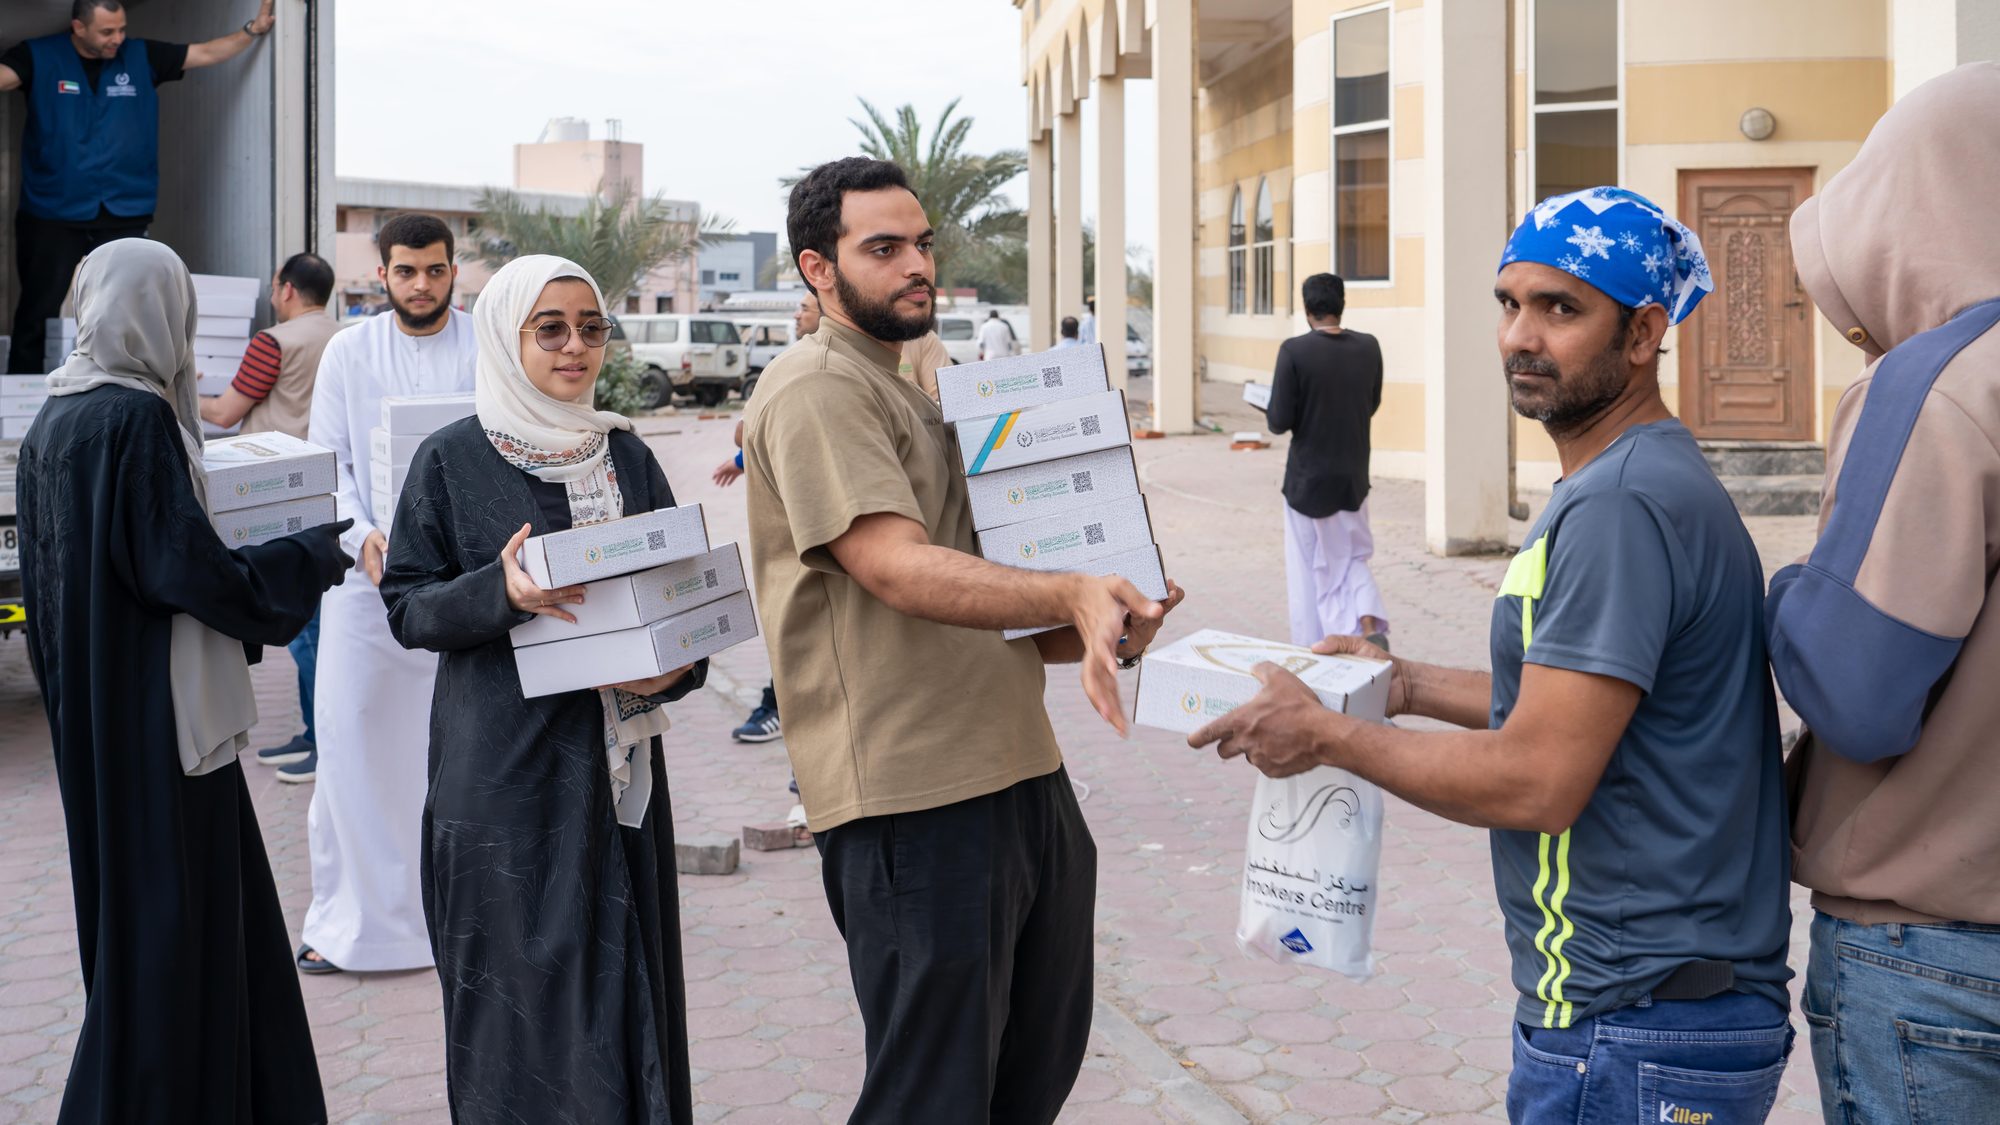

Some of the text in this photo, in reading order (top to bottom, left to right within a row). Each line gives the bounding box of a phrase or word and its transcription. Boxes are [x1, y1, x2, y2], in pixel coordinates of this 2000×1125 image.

[0, 529, 17, 550] 8
[1246, 874, 1305, 905] mokers
[1310, 892, 1366, 915] Centre
[1324, 874, 1368, 896] مركز
[1660, 1100, 1713, 1125] Killer
